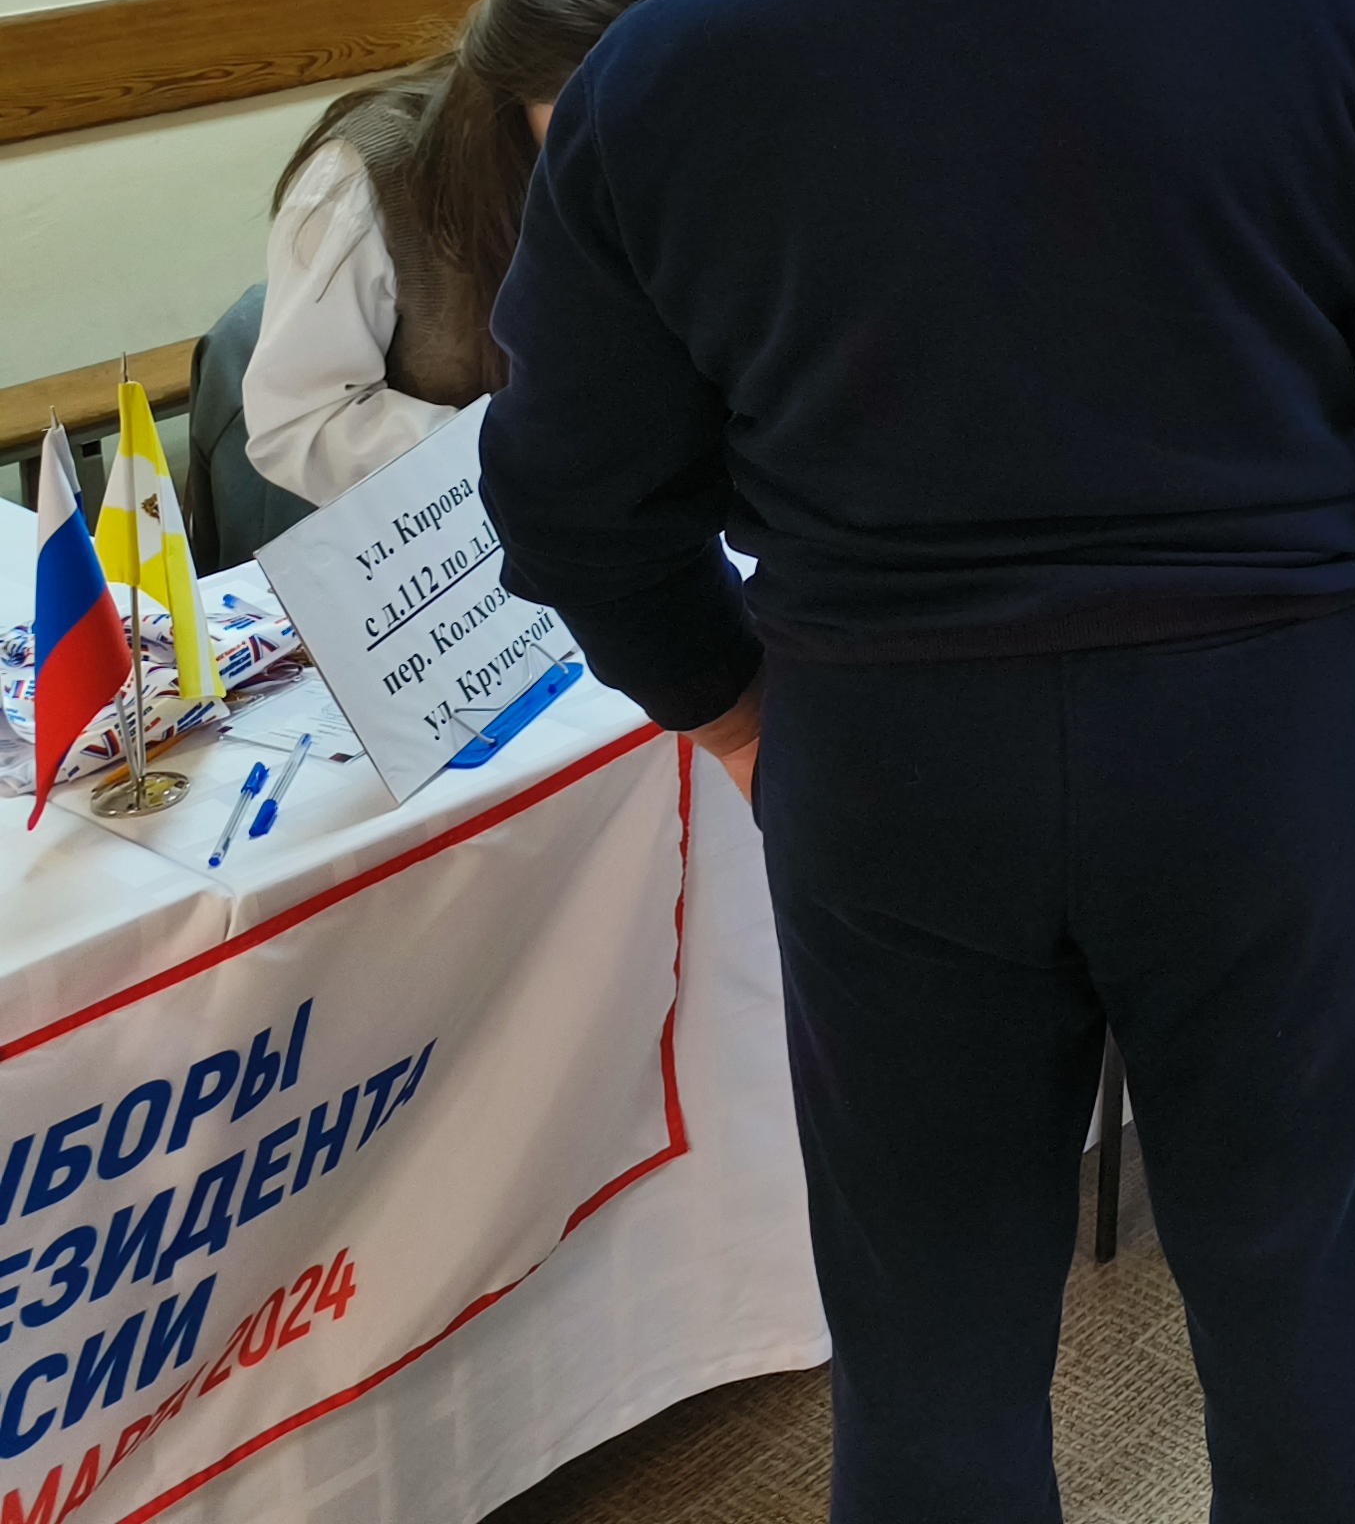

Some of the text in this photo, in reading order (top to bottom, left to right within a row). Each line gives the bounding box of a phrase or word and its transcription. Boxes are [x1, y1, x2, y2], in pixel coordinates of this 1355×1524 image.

[355, 477, 475, 581] ул. Кирова
[364, 616, 381, 638] с
[380, 565, 440, 629] д.112
[440, 549, 469, 581] по
[381, 585, 512, 696] пер. Колхоз
[455, 607, 555, 704] Крупской
[0, 1272, 218, 1460] СИИ
[197, 1246, 357, 1399] 2024
